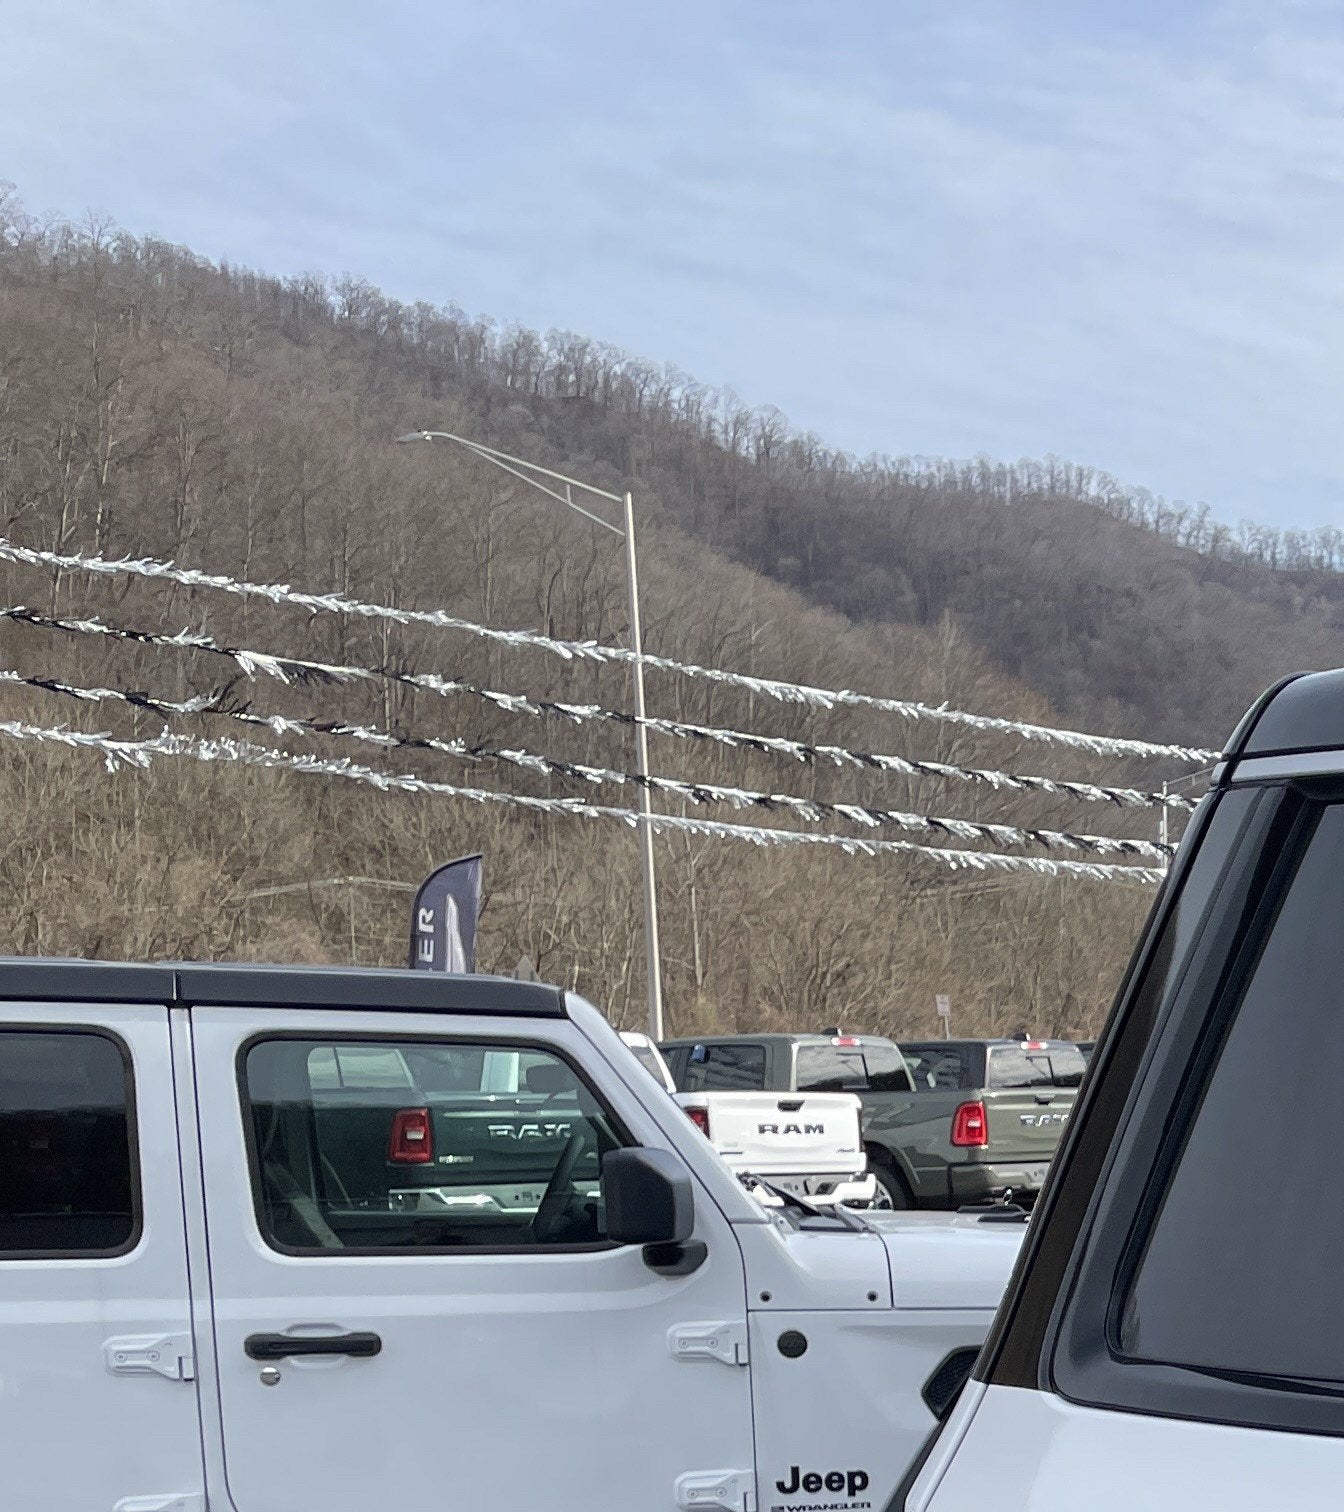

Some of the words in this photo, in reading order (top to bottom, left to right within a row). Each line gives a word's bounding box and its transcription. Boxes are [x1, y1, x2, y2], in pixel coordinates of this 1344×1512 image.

[418, 907, 435, 970] ER
[758, 1124, 824, 1134] RAM
[776, 1465, 869, 1497] Jeep
[786, 1501, 871, 1512] WRANGLER
